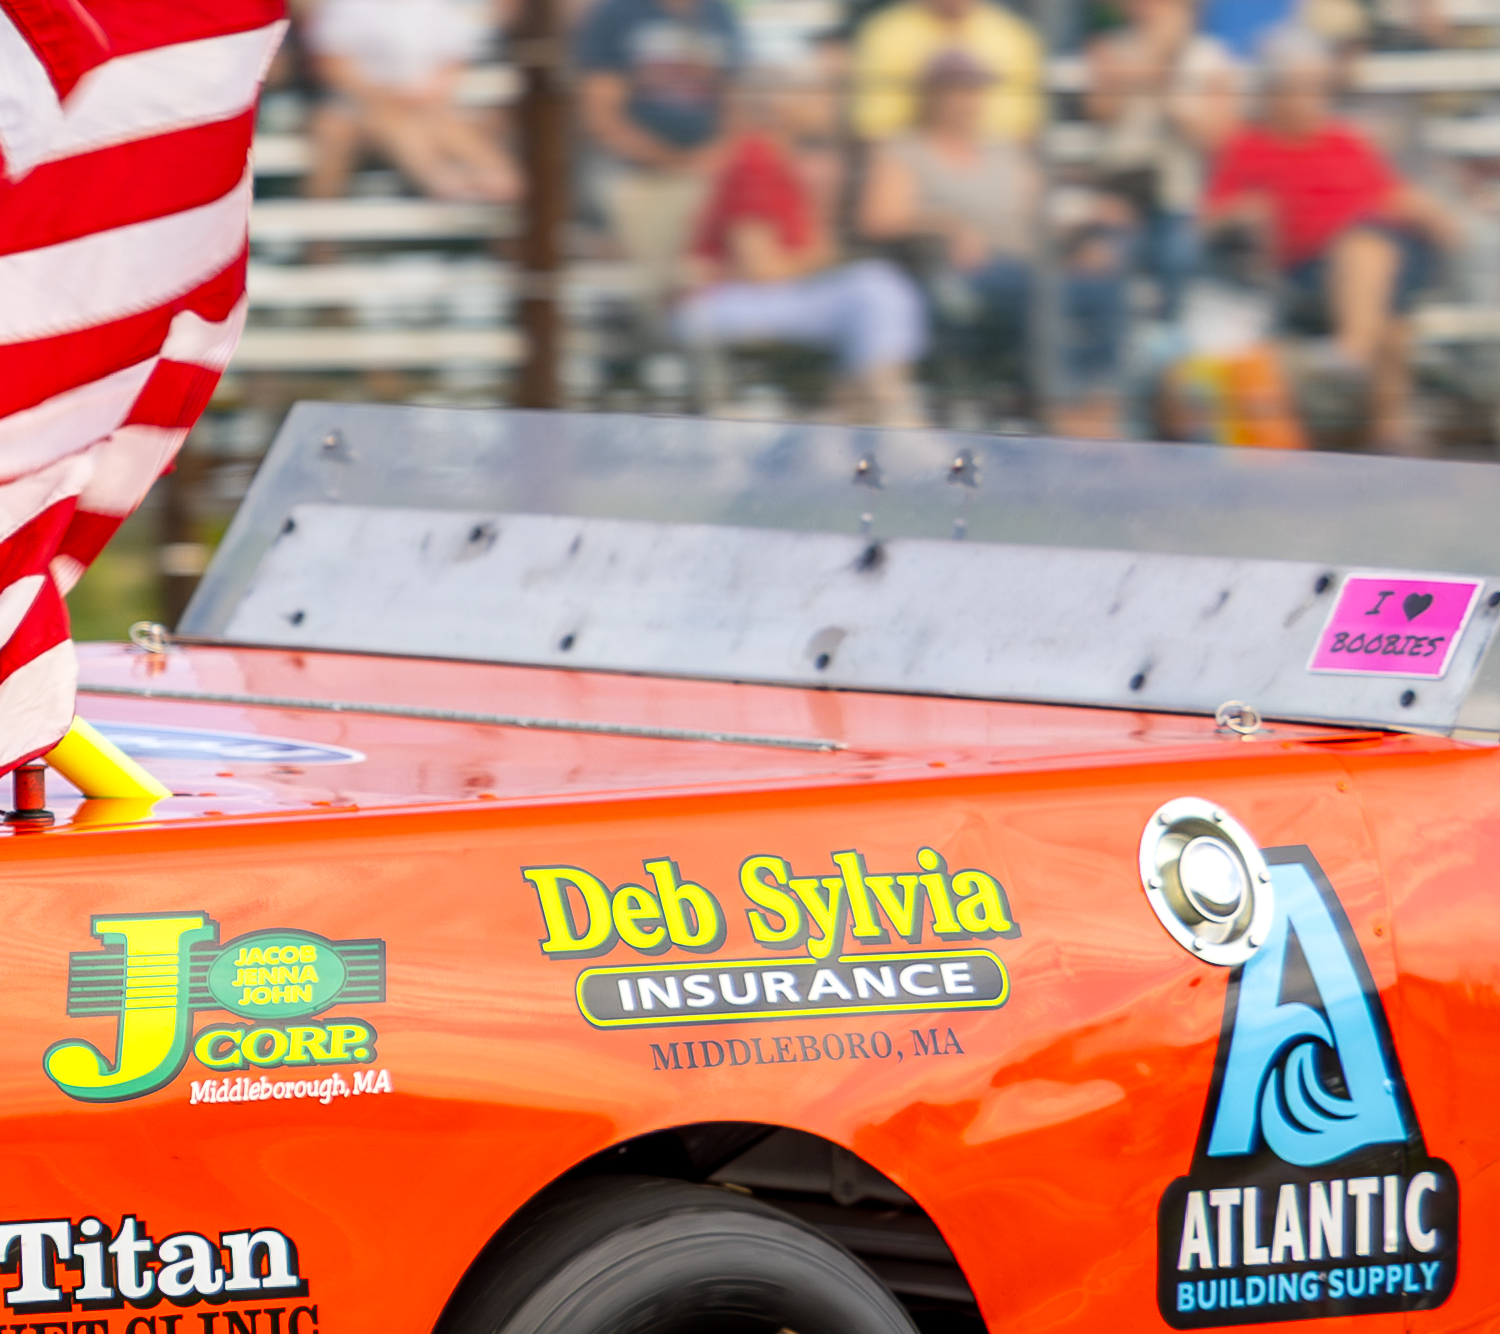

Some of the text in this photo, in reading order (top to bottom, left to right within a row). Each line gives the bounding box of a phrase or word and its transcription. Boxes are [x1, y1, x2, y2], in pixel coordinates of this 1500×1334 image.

[1365, 591, 1395, 616] I
[1329, 631, 1445, 657] BOOBIES
[522, 847, 1019, 959] Deb Sylvia
[231, 964, 319, 987] JENNA
[233, 945, 317, 967] JACOB
[46, 913, 212, 1097] J
[237, 984, 313, 1006] JOHN
[616, 961, 976, 1011] INSURANCE
[193, 1023, 370, 1069] CORP.
[648, 1026, 965, 1072] MIDDLEBORO, MA
[189, 1069, 395, 1105] Middleborough, MA
[1176, 1170, 1439, 1273] ATLANTIC
[1176, 1259, 1442, 1313] BUILDING SUPPLY
